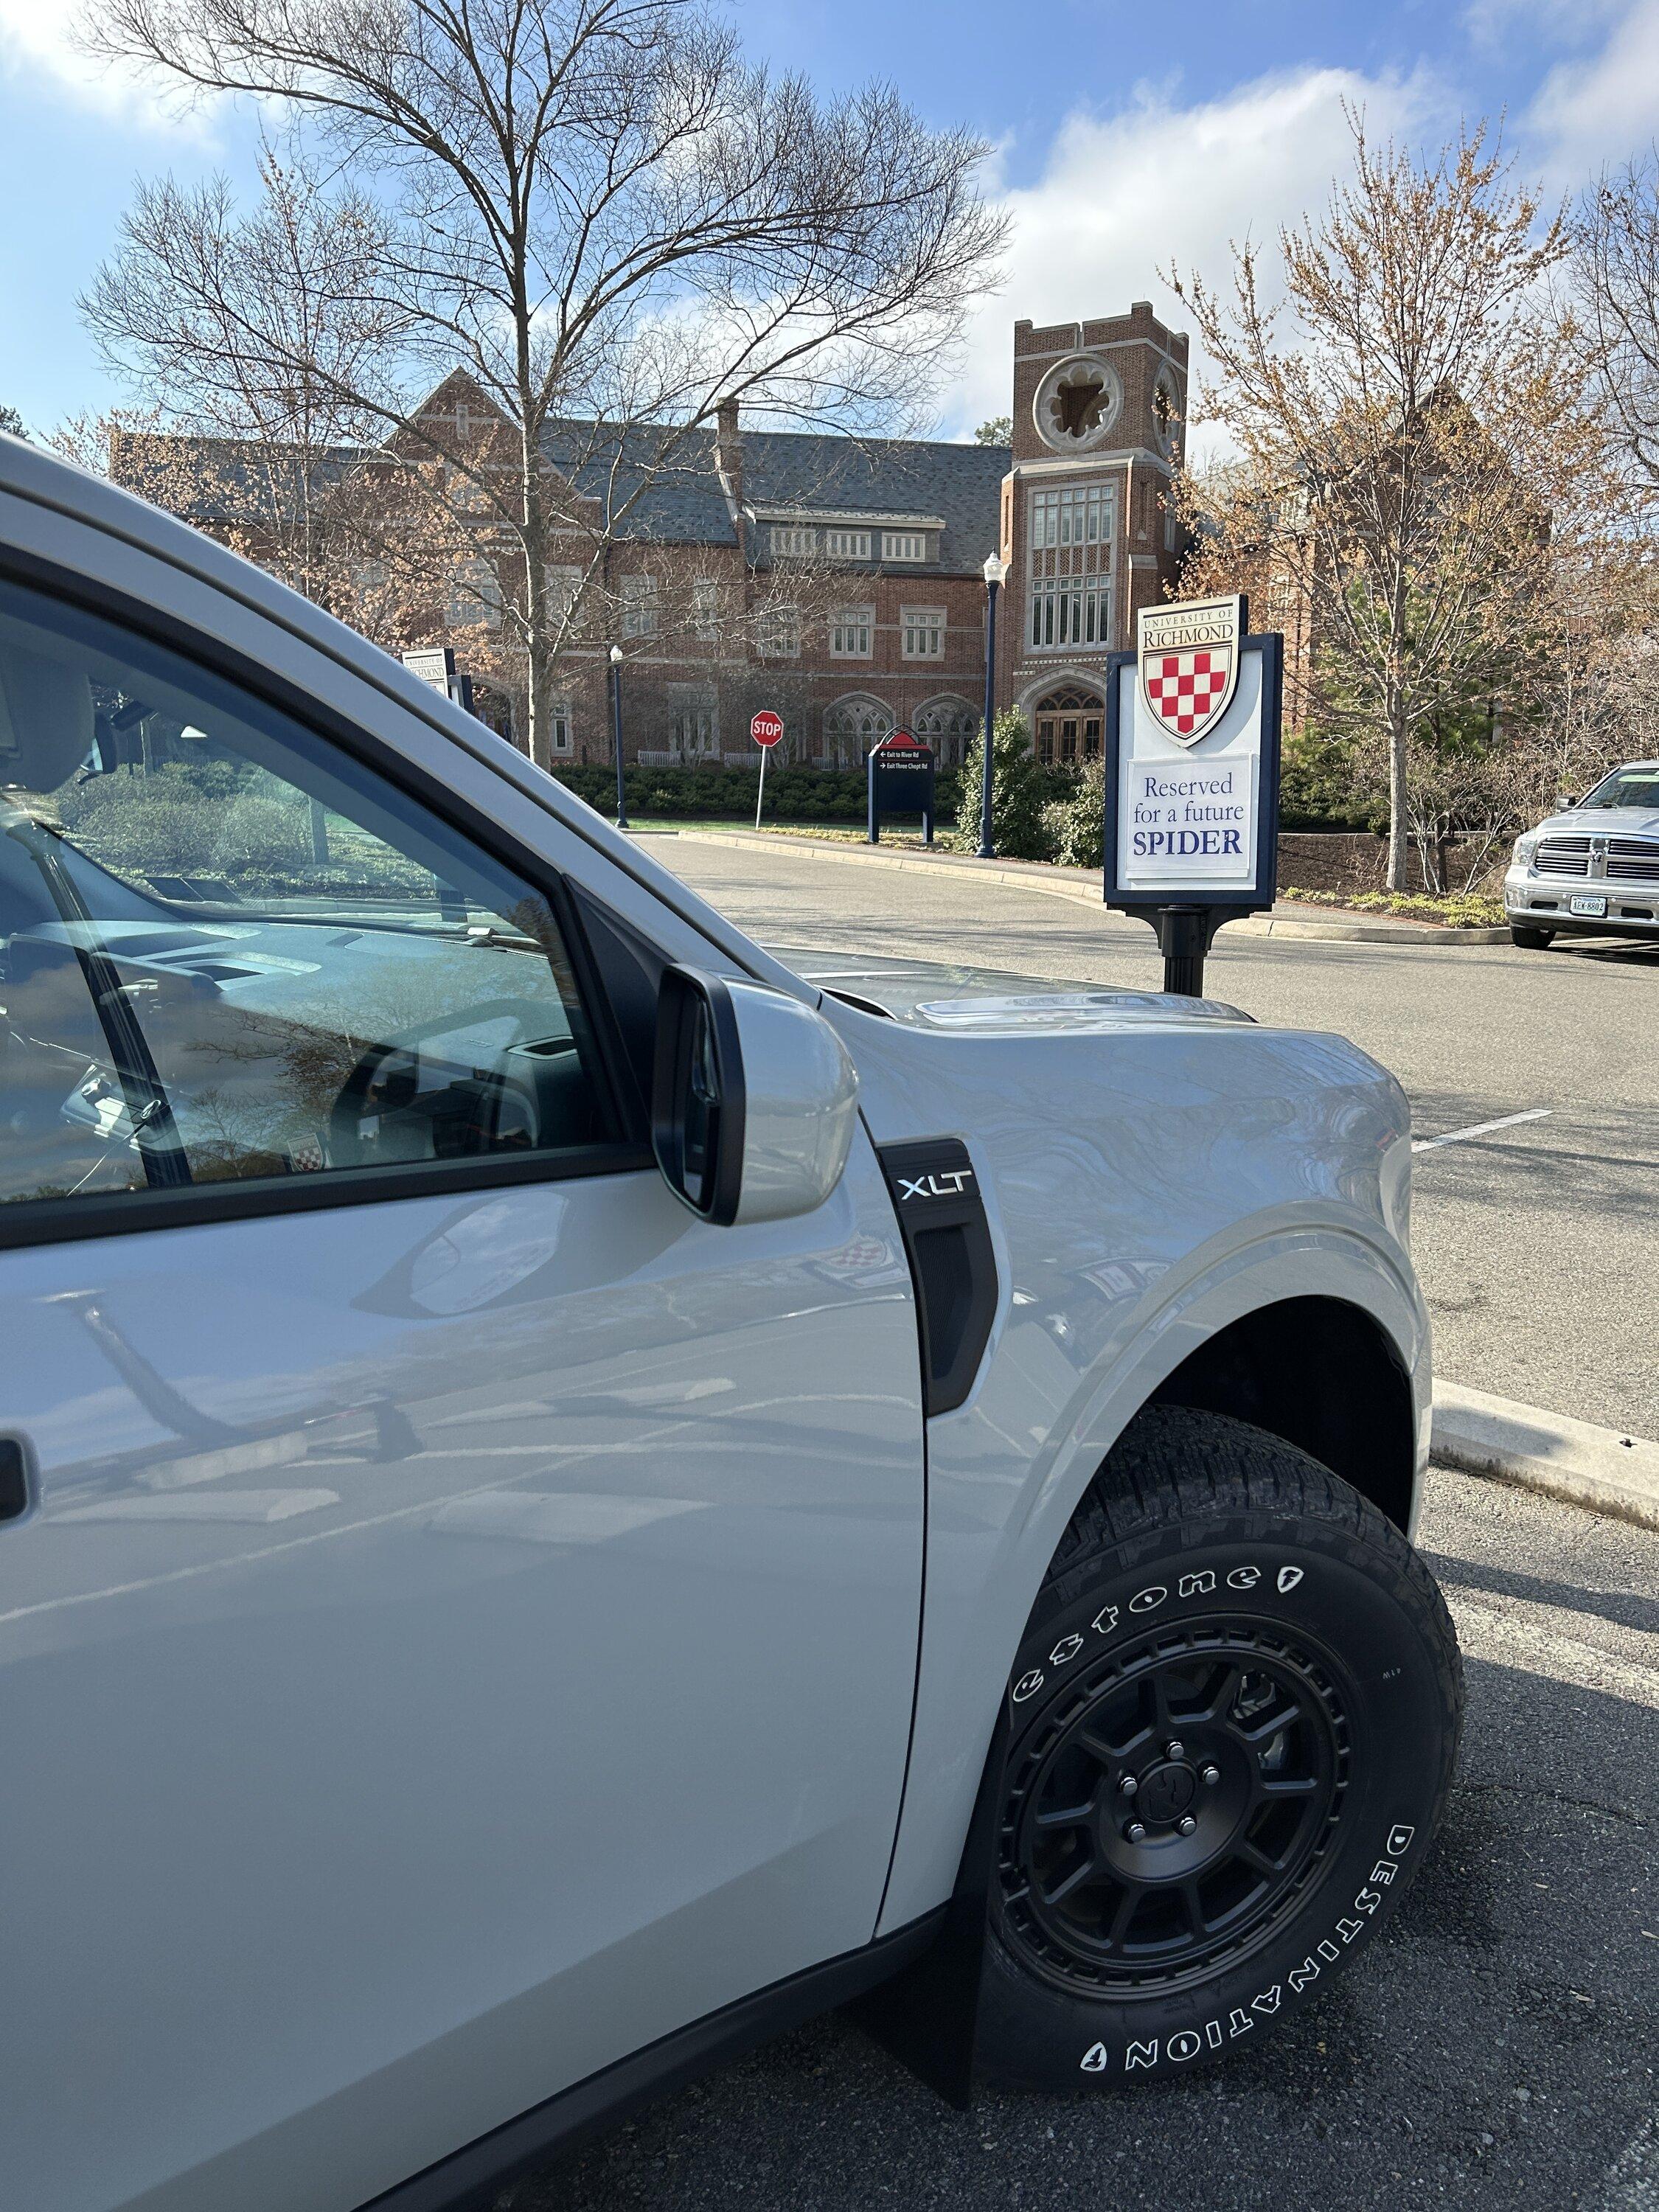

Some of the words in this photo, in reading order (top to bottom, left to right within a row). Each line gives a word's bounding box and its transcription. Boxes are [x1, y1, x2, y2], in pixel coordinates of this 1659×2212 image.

[1144, 611, 1214, 629] UNIVERSITY
[1218, 609, 1233, 618] OF
[753, 720, 782, 737] STOP
[1144, 771, 1233, 797] Reserved
[1133, 802, 1161, 823] for
[1167, 808, 1177, 822] a
[1184, 800, 1245, 821] future
[1133, 829, 1242, 855] SPIDER
[897, 1169, 973, 1200] XLT
[1124, 1823, 1414, 2072] DESTINATION
